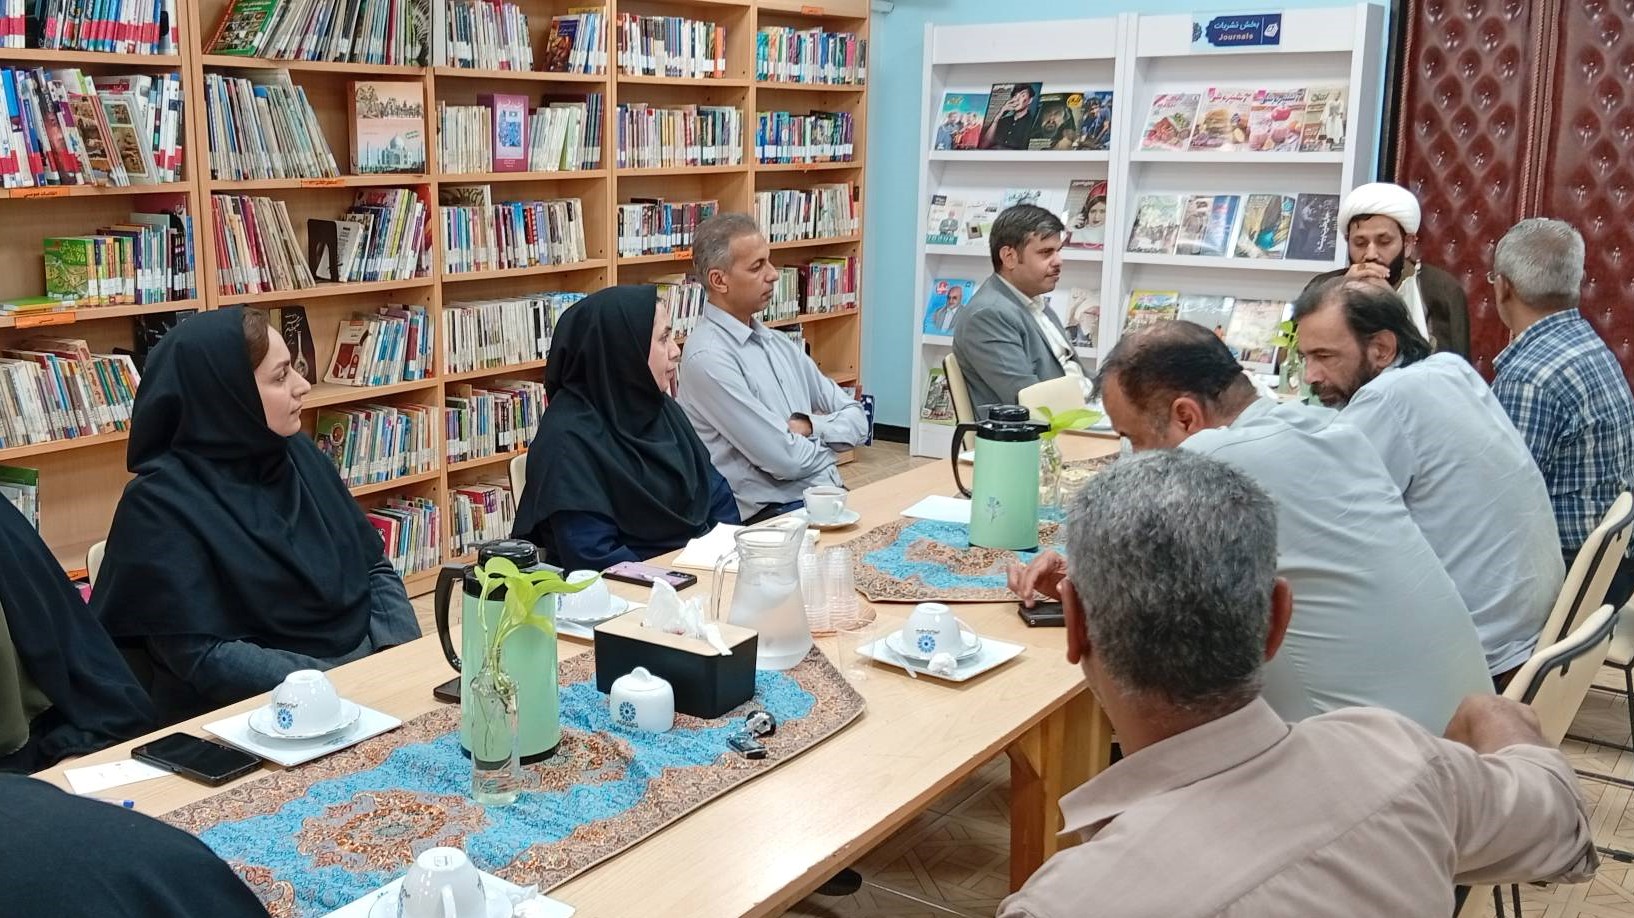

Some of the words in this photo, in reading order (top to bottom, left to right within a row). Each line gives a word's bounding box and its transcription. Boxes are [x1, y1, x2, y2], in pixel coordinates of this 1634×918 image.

[1213, 19, 1239, 32] نشریات
[1239, 20, 1260, 31] بخش
[1219, 32, 1254, 41] Journals
